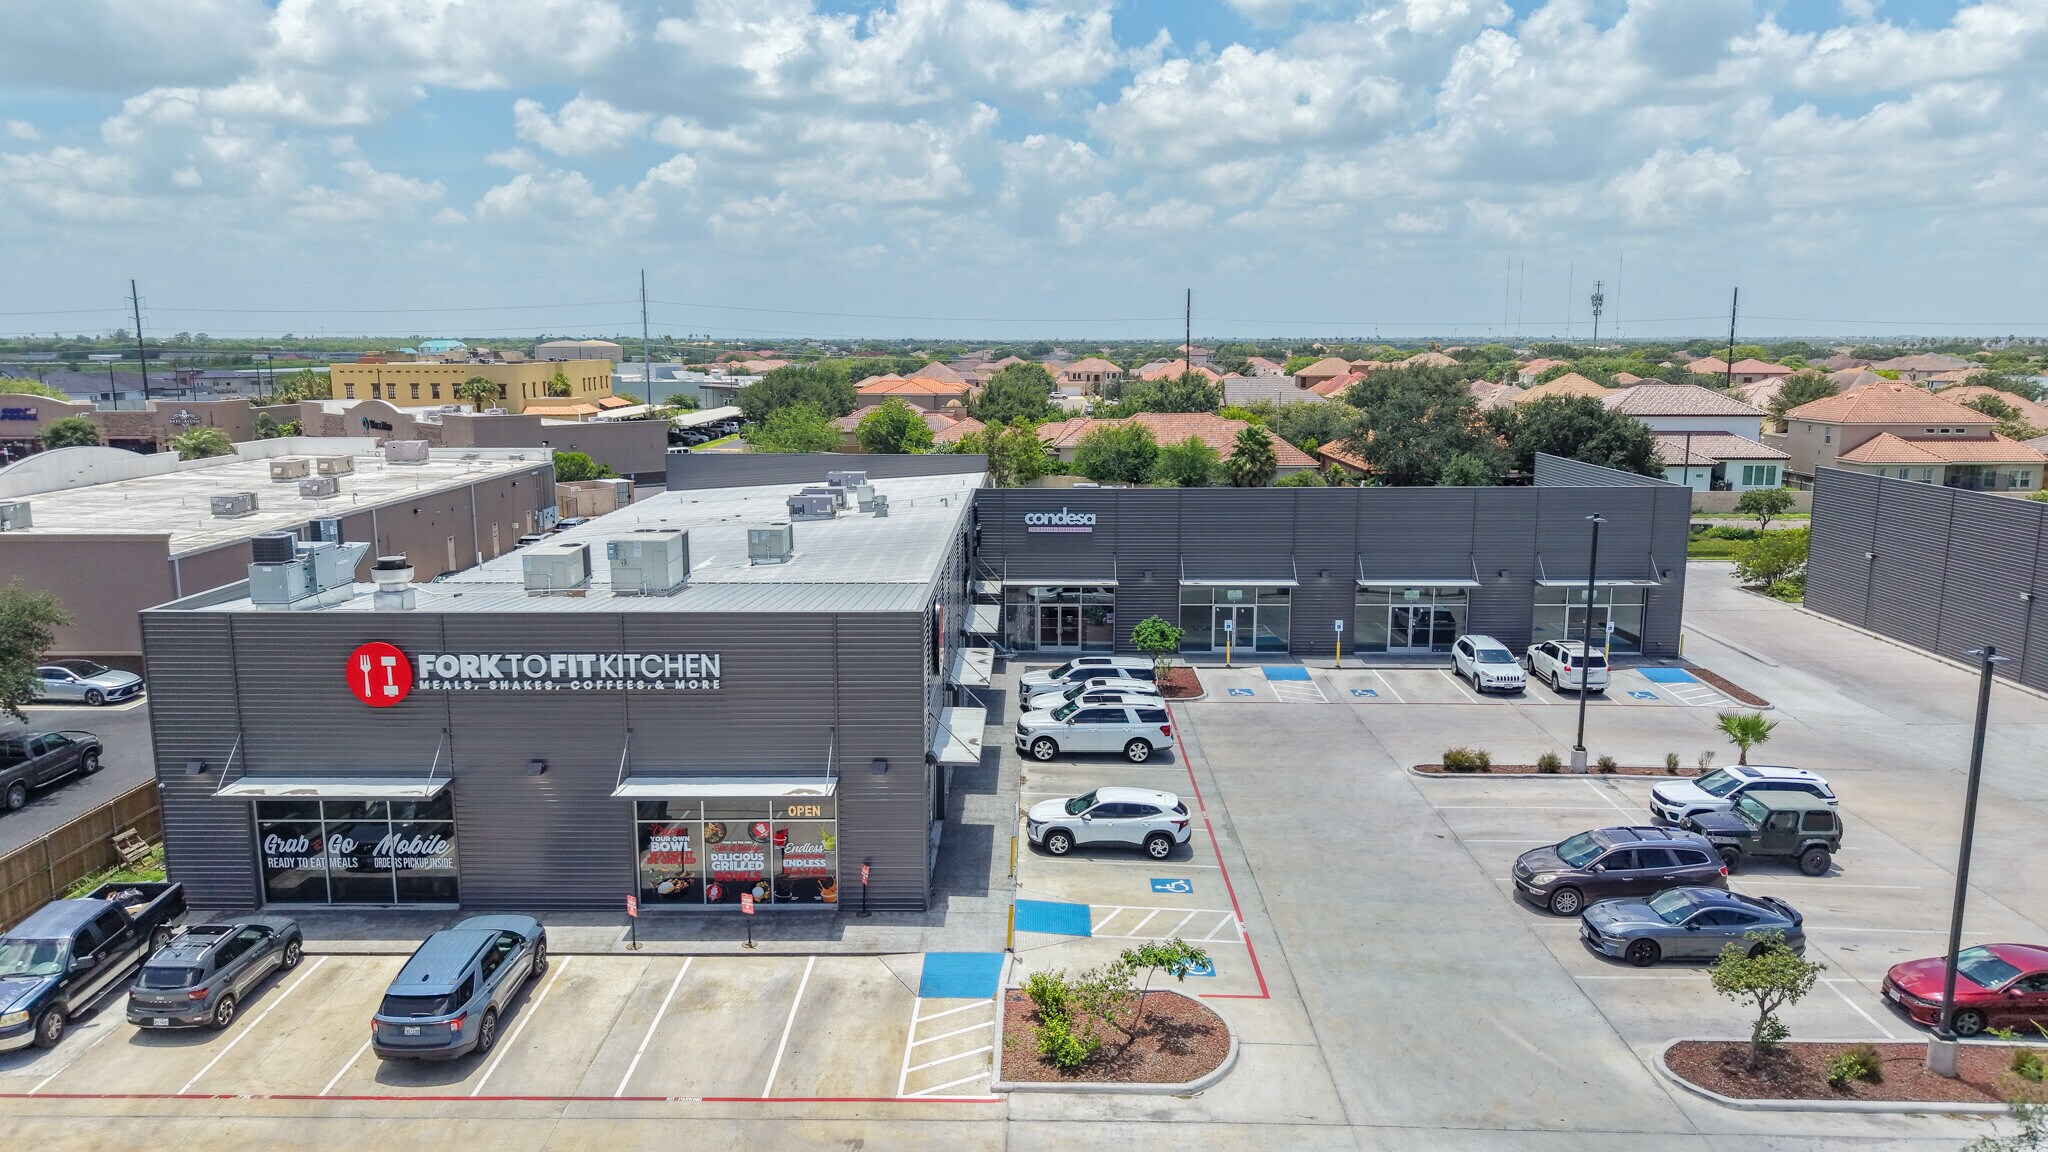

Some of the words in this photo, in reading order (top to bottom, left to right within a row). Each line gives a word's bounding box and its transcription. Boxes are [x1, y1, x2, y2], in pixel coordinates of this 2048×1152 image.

[1024, 506, 1096, 525] condesa
[419, 680, 480, 691] MEALS,
[489, 680, 561, 691] SHAKES,
[675, 680, 721, 691] MORE
[787, 805, 821, 817] OPEN
[264, 834, 310, 855] Grab
[328, 834, 359, 855] Go
[372, 833, 452, 857] Mobile
[650, 841, 692, 852] BOWL
[784, 842, 825, 854] Endless
[374, 857, 403, 868] ORDERS
[403, 857, 429, 868] PICKUP
[429, 857, 453, 868] INSIDE
[710, 853, 765, 861] DELICIOUS
[267, 857, 295, 869] READY
[297, 857, 308, 869] TO
[310, 857, 326, 869] EAT
[329, 857, 359, 869] MEALS
[711, 860, 765, 871] GRILLED
[783, 859, 827, 867] ENDLESS
[714, 870, 762, 882] BOWLS
[783, 867, 827, 876] FLAVOR
